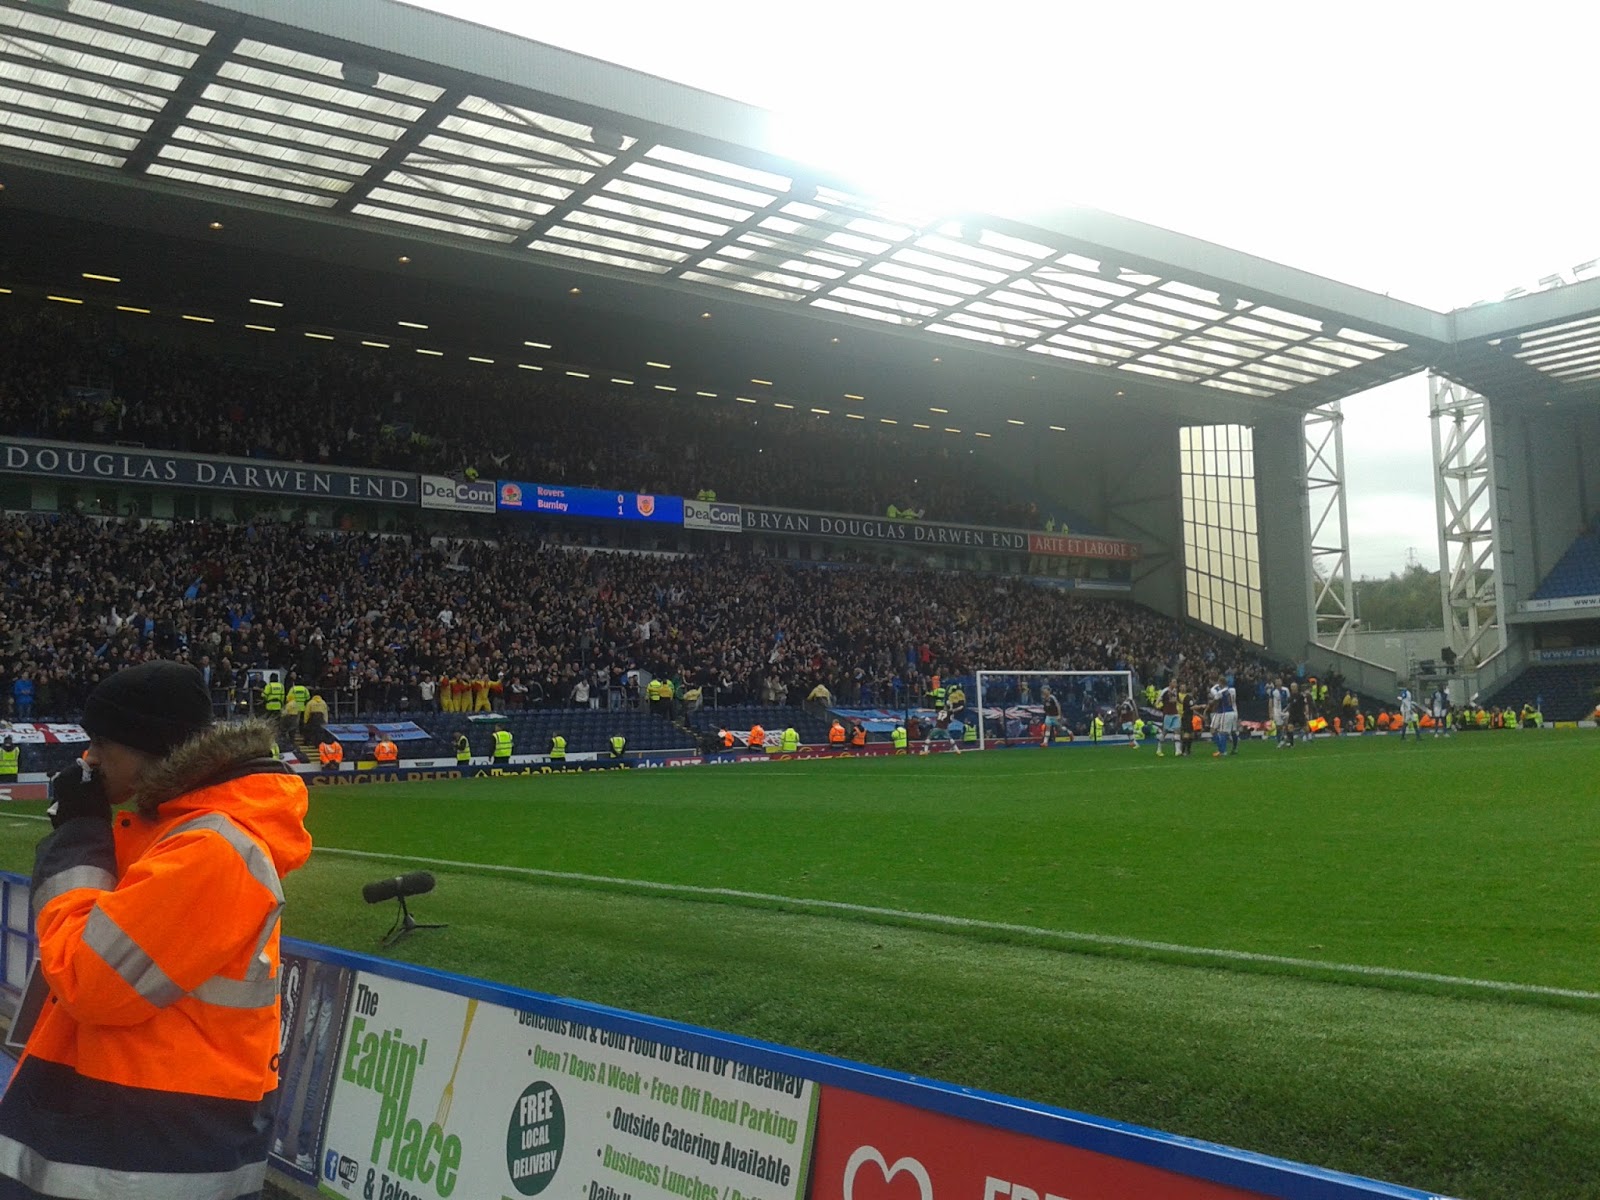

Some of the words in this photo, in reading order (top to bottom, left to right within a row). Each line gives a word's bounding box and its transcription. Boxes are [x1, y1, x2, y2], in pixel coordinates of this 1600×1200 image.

[6, 446, 177, 481] DOUGLAS
[196, 463, 331, 494] DARWEN
[349, 476, 408, 500] END
[422, 481, 494, 502] DeaCom
[537, 486, 565, 498] Rovers
[617, 494, 625, 504] 0
[537, 499, 569, 512] Burnley
[618, 505, 624, 515] 1
[685, 506, 740, 523] DeaCom
[746, 511, 810, 532] BRYAN
[819, 519, 906, 539] DOUGLAS
[913, 527, 985, 546] DARWEN
[992, 533, 1024, 549] END
[1035, 537, 1065, 552] ARTE
[1068, 539, 1081, 553] ET
[1084, 541, 1128, 556] LABORE
[355, 983, 379, 1017] The
[520, 1088, 554, 1127] FREE
[533, 1044, 561, 1071] Open
[562, 1052, 569, 1073] 7
[569, 1053, 597, 1082] Days
[597, 1061, 606, 1084] A
[607, 1063, 641, 1095] Week
[650, 1076, 679, 1106] Free
[681, 1084, 701, 1113] Off
[702, 1090, 739, 1124] Road
[739, 1101, 798, 1146] Parking
[370, 1090, 462, 1198] Place
[521, 1124, 550, 1151] LOCAL
[612, 1106, 660, 1143] Outside
[661, 1121, 721, 1166] Catering
[721, 1141, 791, 1187] Available
[513, 1150, 557, 1180] DELIVERY
[603, 1144, 661, 1186] Business
[661, 1165, 719, 1200] Lunches
